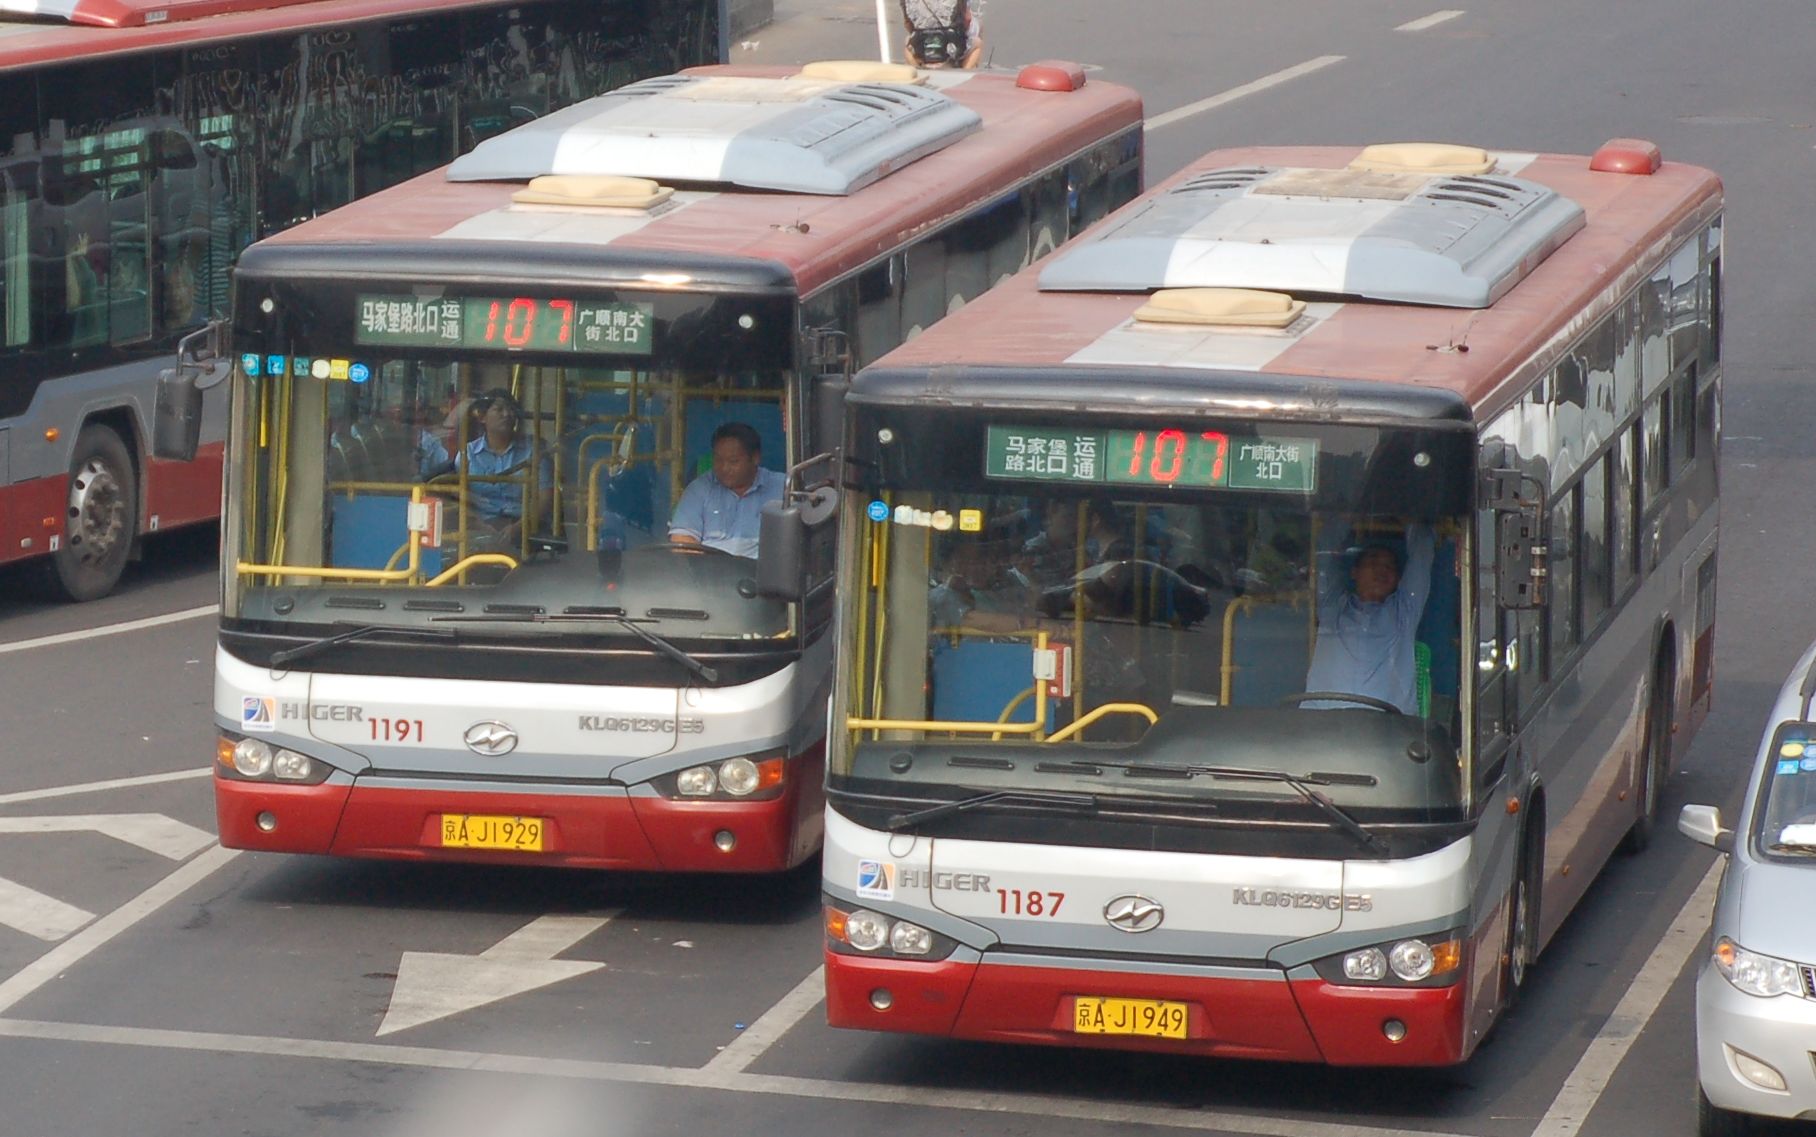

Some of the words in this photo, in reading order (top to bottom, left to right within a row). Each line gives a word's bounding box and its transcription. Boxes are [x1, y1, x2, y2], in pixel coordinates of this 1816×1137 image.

[361, 301, 438, 334] 马家堡路北口
[441, 300, 460, 340] 运通
[484, 298, 574, 345] 107
[585, 325, 638, 343] 街北口
[1005, 436, 1067, 456] 马家堡
[1072, 436, 1096, 479] 运通
[1129, 429, 1227, 482] 107
[1005, 455, 1067, 474] 路北口
[1256, 462, 1282, 480] 北口
[281, 703, 363, 721] HIGER
[368, 718, 423, 742] 1191
[900, 869, 991, 892] HIGER
[996, 889, 1065, 917] 1187
